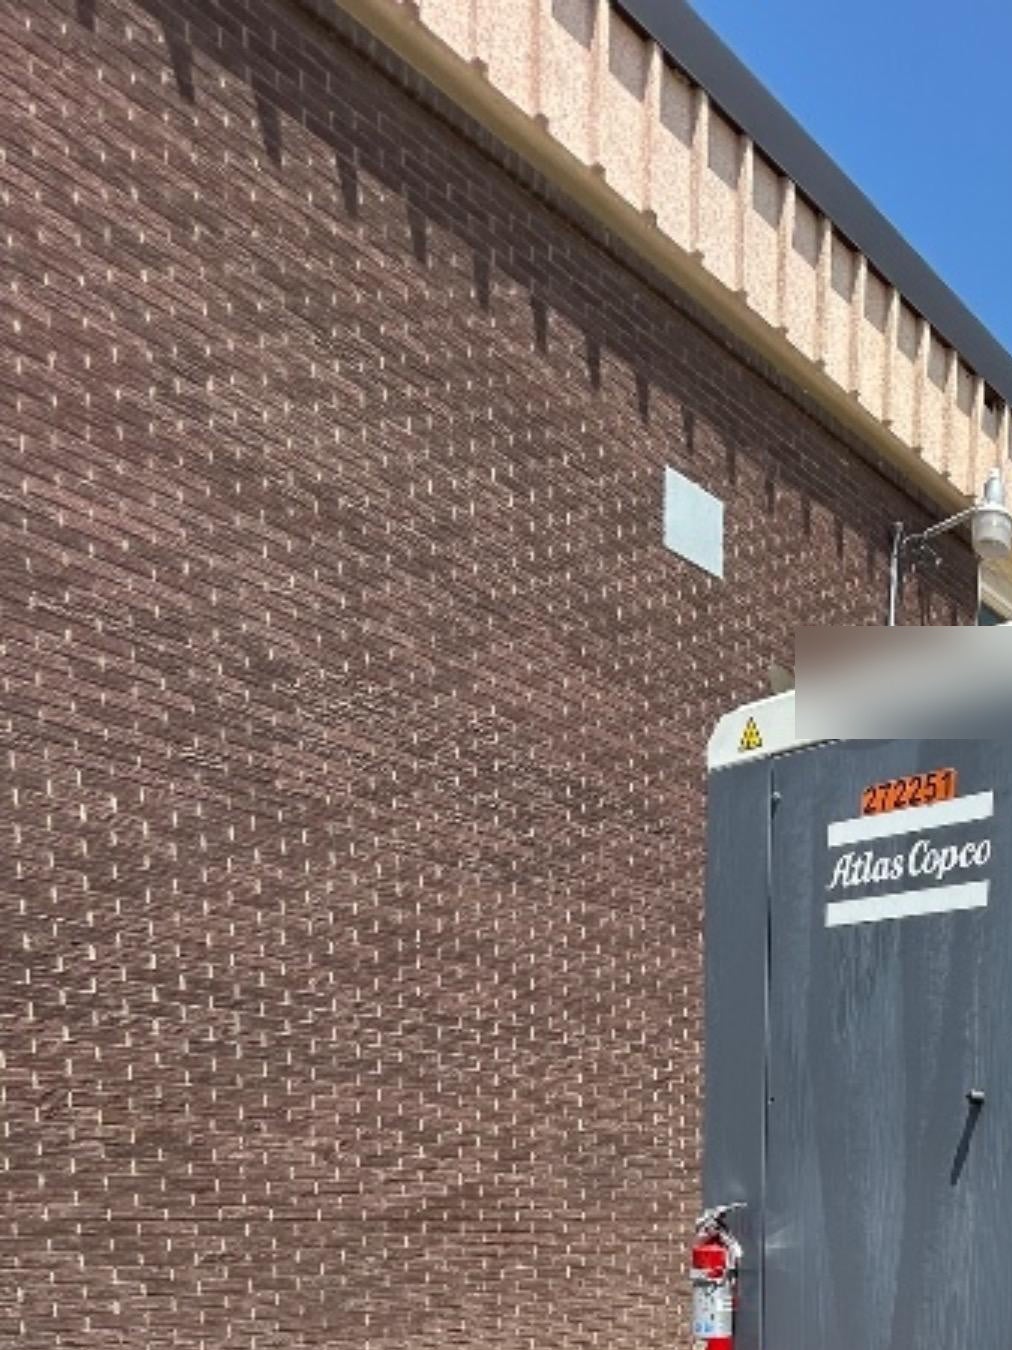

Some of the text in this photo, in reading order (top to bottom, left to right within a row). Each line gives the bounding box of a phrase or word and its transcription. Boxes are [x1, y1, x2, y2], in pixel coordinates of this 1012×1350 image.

[863, 770, 952, 815] 272251
[825, 839, 991, 891] Atlas Copco
